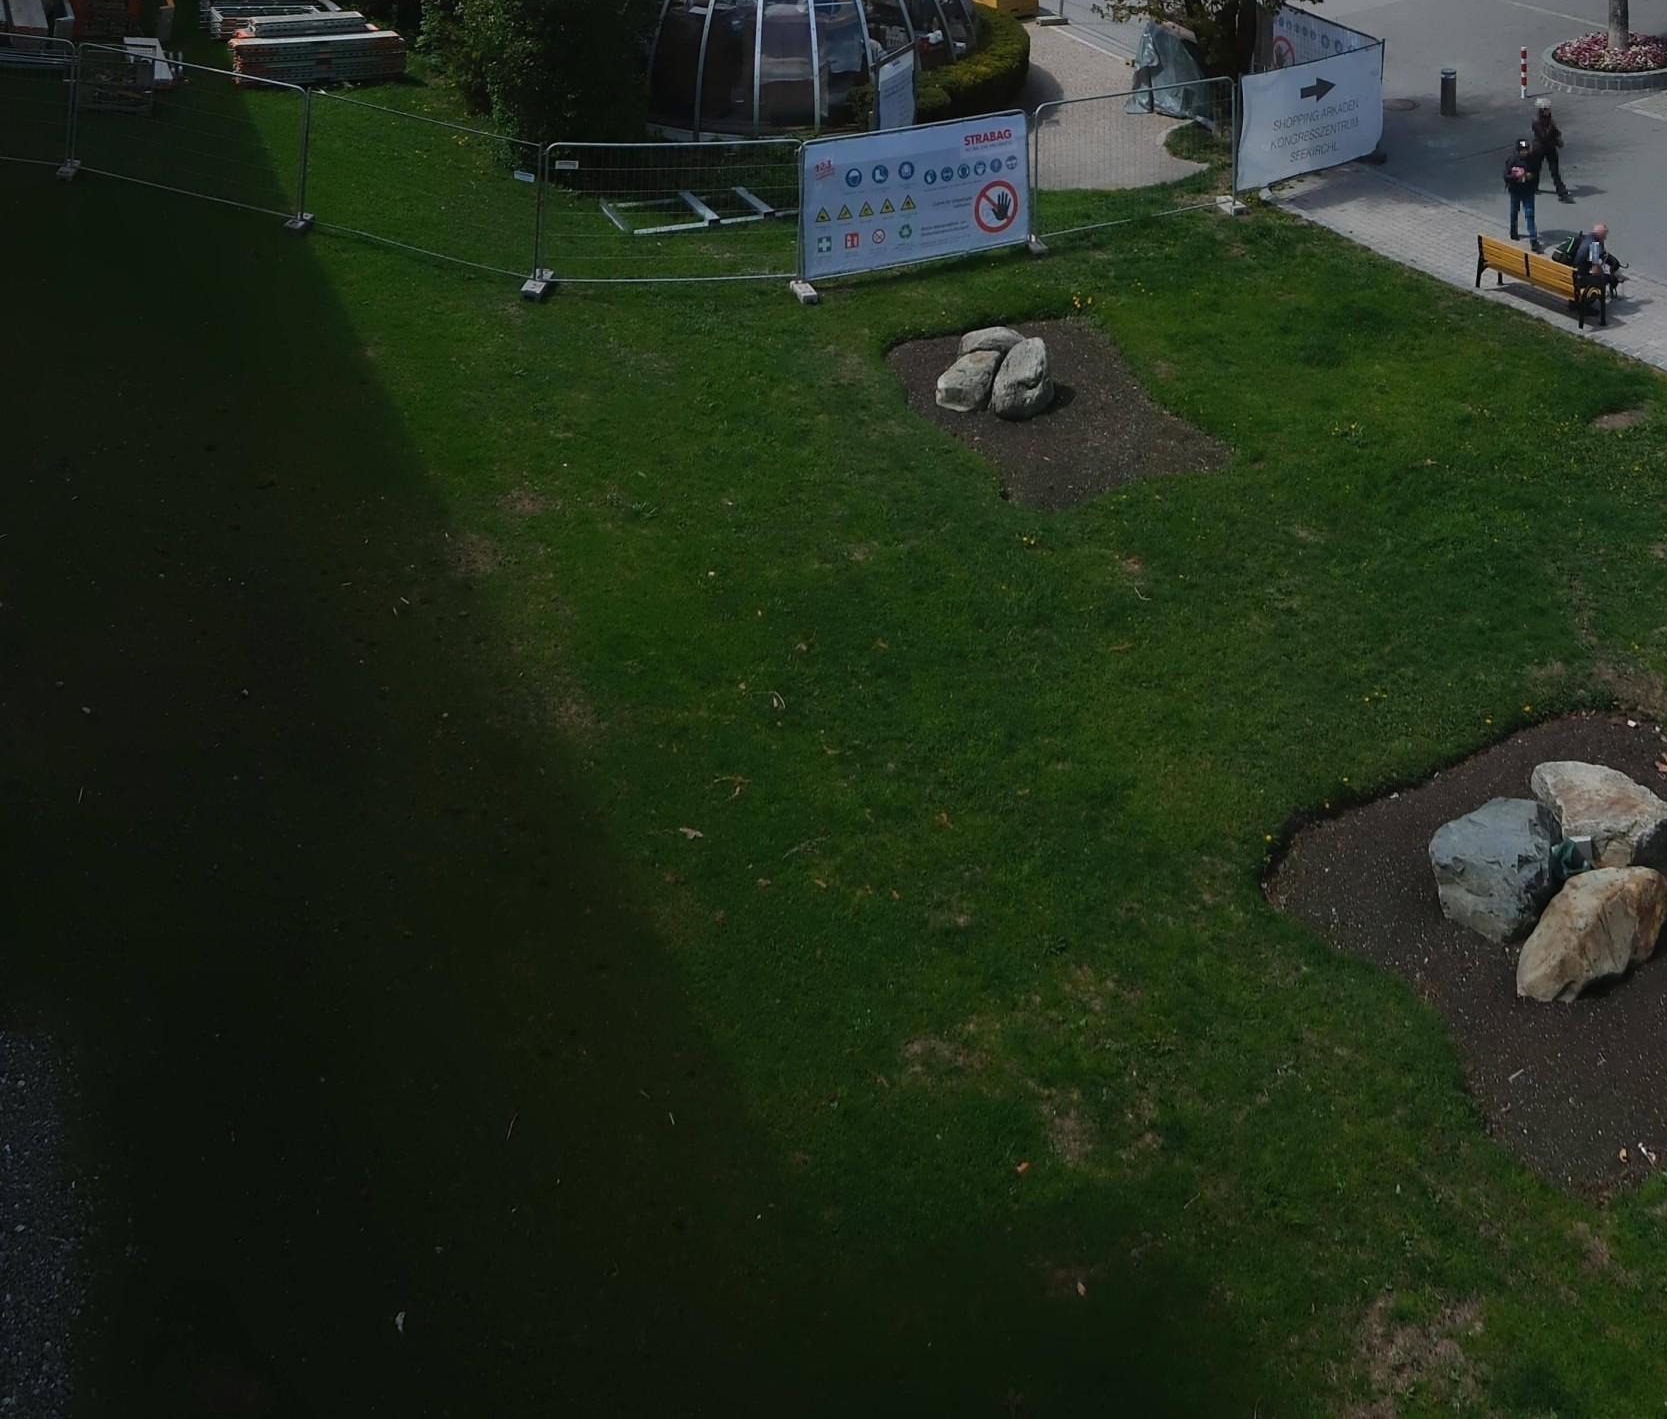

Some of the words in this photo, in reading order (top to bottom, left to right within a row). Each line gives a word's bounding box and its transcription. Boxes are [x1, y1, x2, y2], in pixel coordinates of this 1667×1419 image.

[1272, 111, 1320, 132] SHOPPING
[1320, 99, 1360, 119] ARKADEN
[963, 129, 1012, 146] STRABAG
[1269, 116, 1360, 150] KONGRESSZENTRUM
[1289, 141, 1339, 163] SEEKIRCHL
